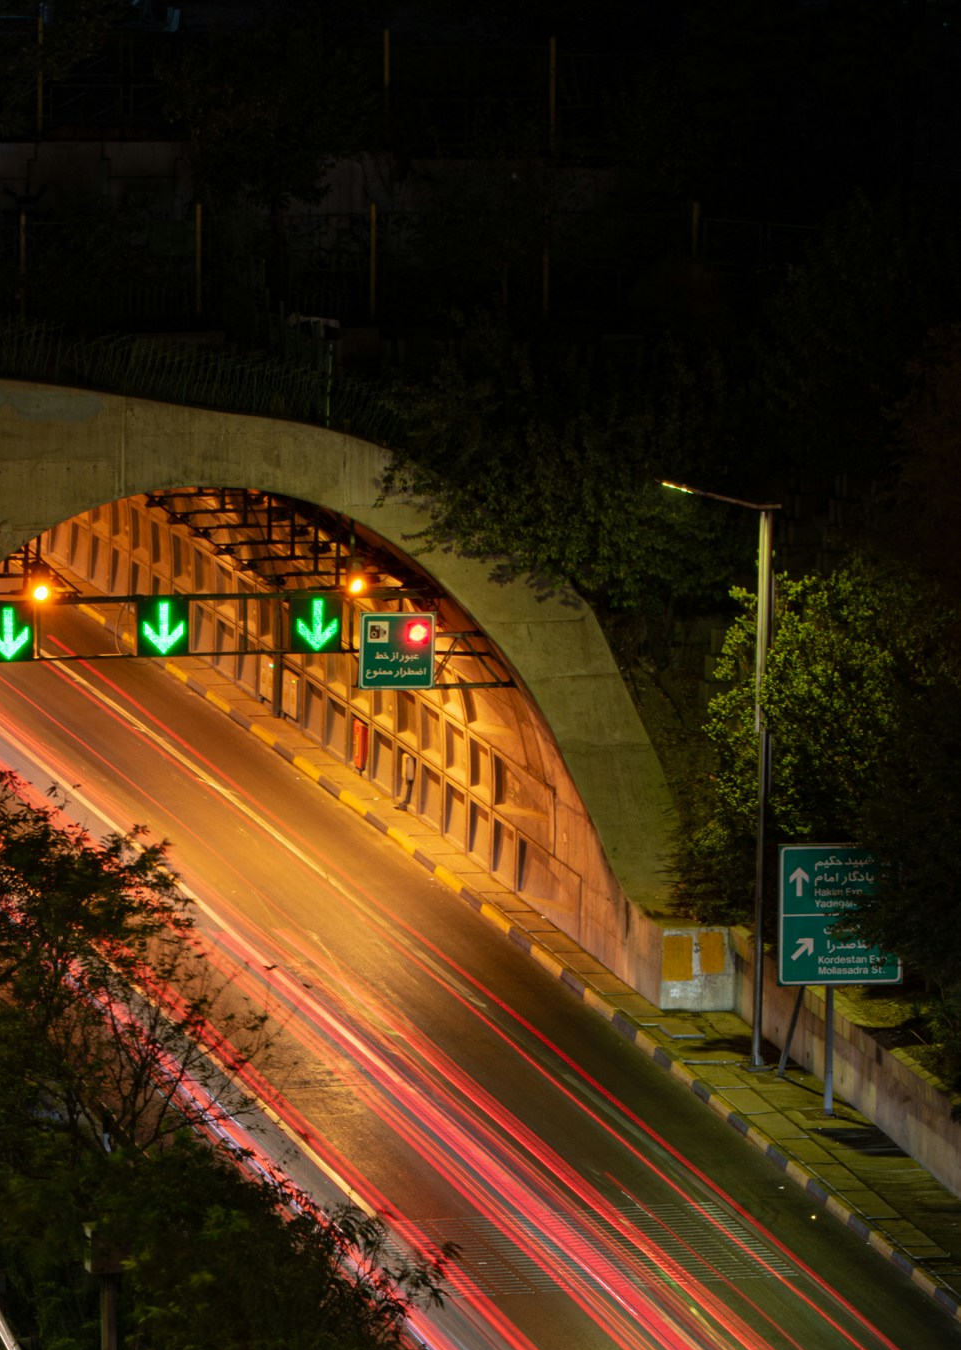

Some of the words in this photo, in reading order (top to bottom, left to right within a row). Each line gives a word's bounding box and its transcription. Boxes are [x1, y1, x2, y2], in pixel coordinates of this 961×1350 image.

[390, 652, 399, 661] از
[399, 654, 419, 663] عبور
[365, 668, 393, 679] ممنوع
[394, 667, 426, 677] اضطرار
[814, 855, 843, 871] حکیم
[814, 872, 839, 886] امام
[841, 871, 875, 885] یادگار
[814, 888, 843, 896] Hakim
[818, 955, 867, 964] Kordestan
[818, 966, 869, 975] Mollasadra
[871, 965, 886, 974] St.
